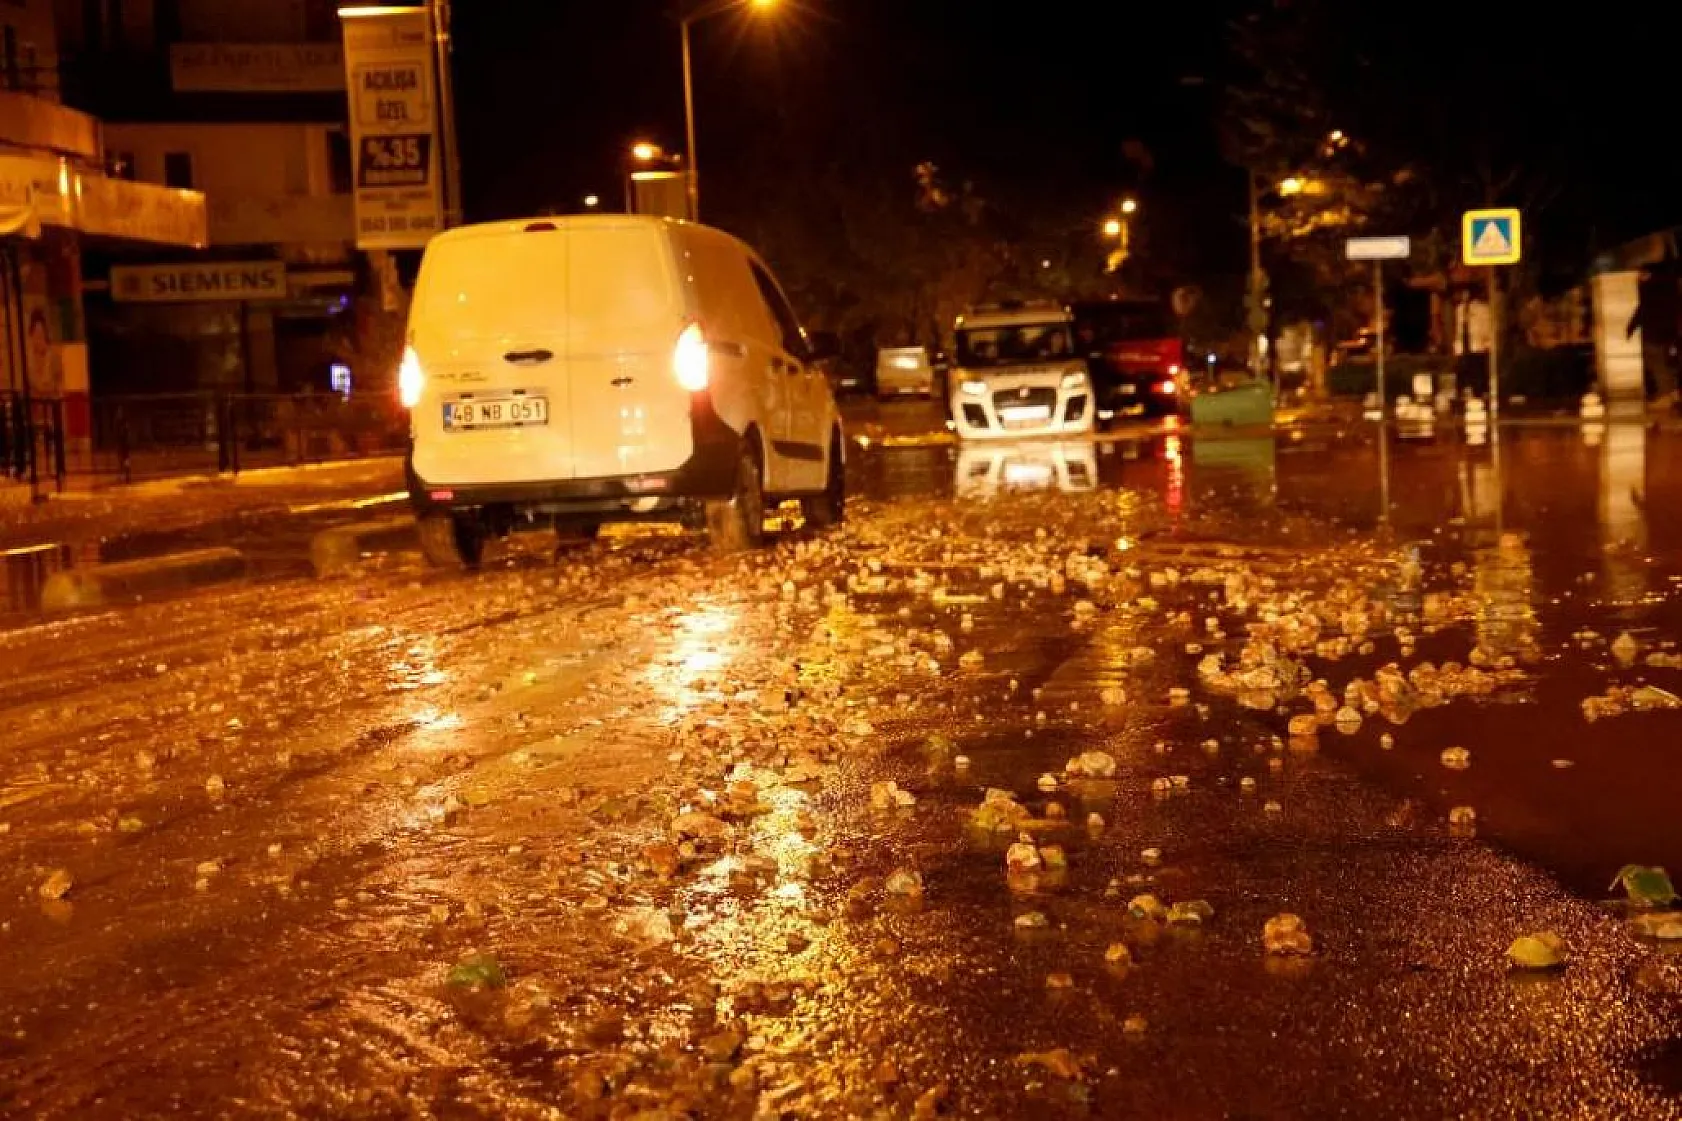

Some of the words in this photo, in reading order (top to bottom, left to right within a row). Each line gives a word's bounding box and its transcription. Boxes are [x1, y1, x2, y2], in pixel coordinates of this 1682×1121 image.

[366, 138, 420, 166] %35
[151, 268, 276, 293] SIEMENS
[453, 404, 474, 422] 48
[481, 403, 502, 420] NB
[511, 401, 542, 419] 051
